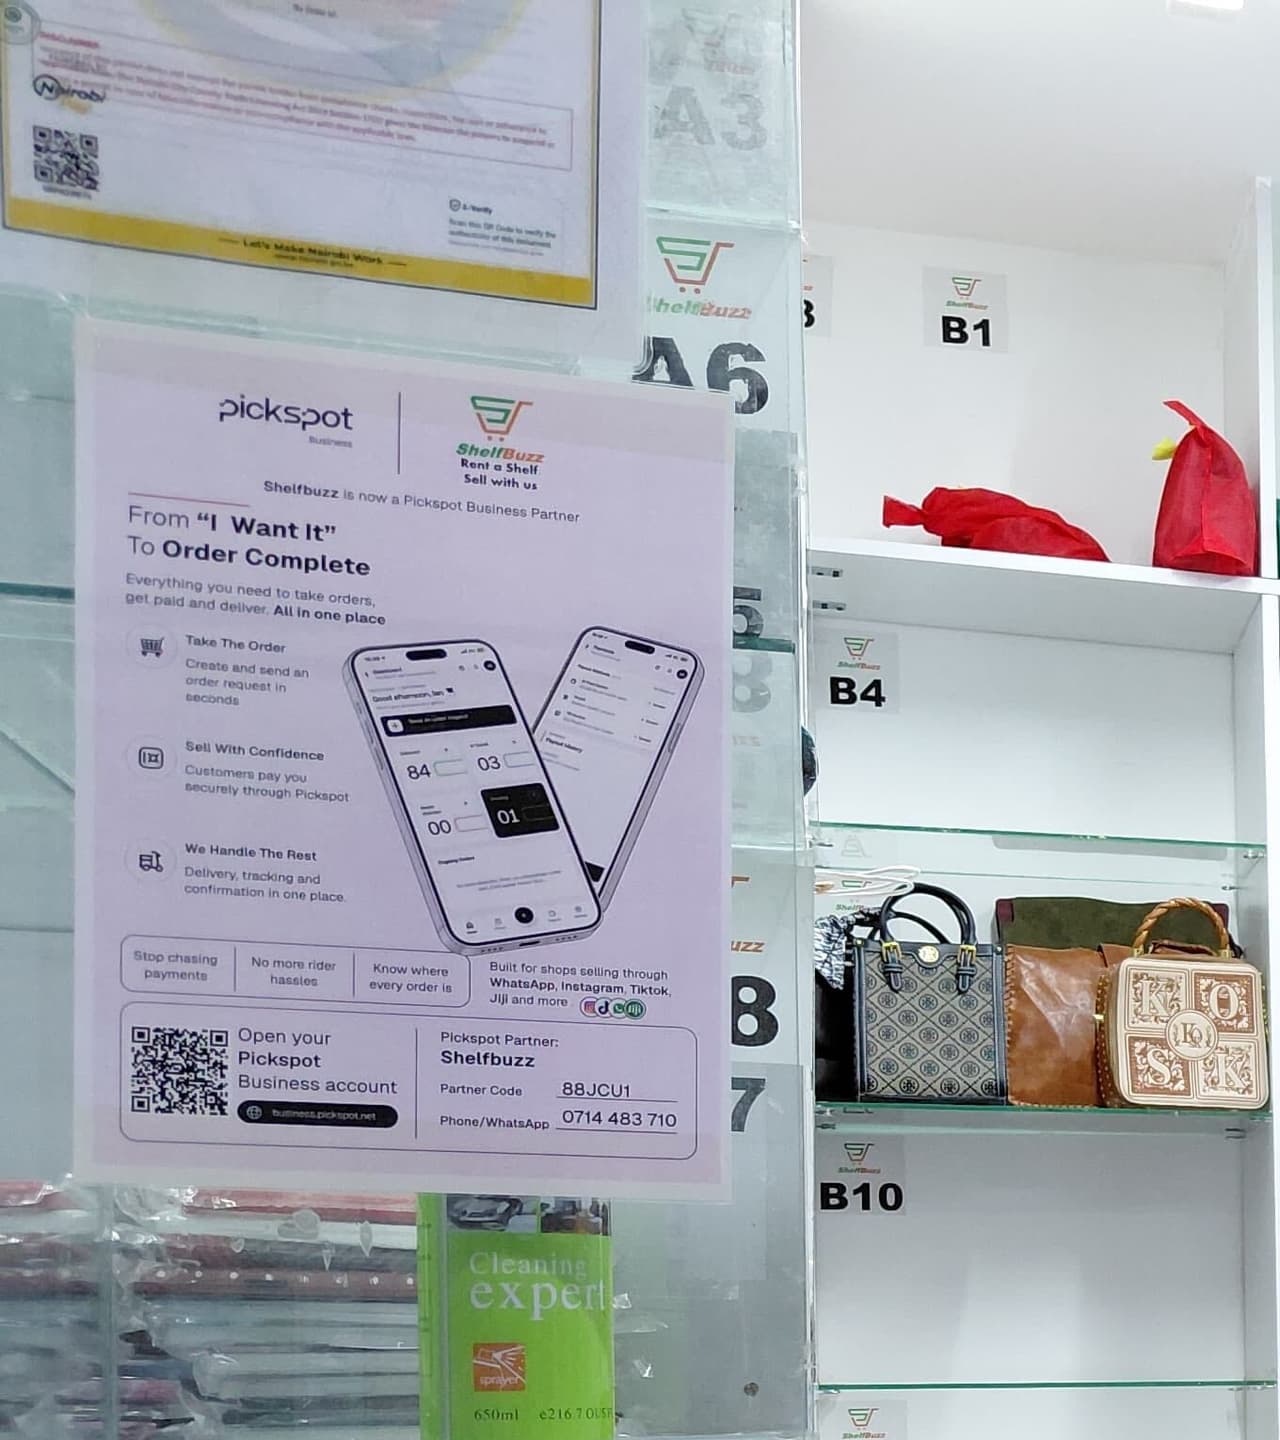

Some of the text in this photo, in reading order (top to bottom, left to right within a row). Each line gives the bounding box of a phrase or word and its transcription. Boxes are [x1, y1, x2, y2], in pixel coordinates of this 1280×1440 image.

[942, 315, 991, 347] B1
[632, 336, 768, 414] A6
[219, 394, 353, 431] pickspot
[455, 443, 544, 464] ShelfBuzz
[461, 458, 538, 476] Rent a Shelf
[464, 474, 537, 491] Sell with us
[264, 480, 339, 500] Shelfbuzz
[343, 488, 355, 501] is
[359, 492, 388, 504] now
[404, 495, 462, 512] Pickspot
[466, 501, 527, 518] Business
[531, 507, 580, 523] Partner
[128, 505, 190, 529] From
[231, 516, 299, 540] Want
[127, 535, 371, 577] To Order Complete
[829, 676, 886, 708] B4
[238, 1027, 331, 1047] Open your
[440, 1031, 559, 1047] Pickspot Partner:
[238, 1051, 321, 1070] Pickspot
[440, 1050, 535, 1067] Shelfbuzz
[238, 1075, 398, 1095] Business account
[440, 1082, 630, 1098] Partner Code 88JCU1
[440, 1110, 677, 1131] Phone/WhatsApp 0714 483 710
[820, 1182, 904, 1211] B10
[470, 1252, 588, 1279] Cleaning
[474, 1407, 519, 1421] 650ml
